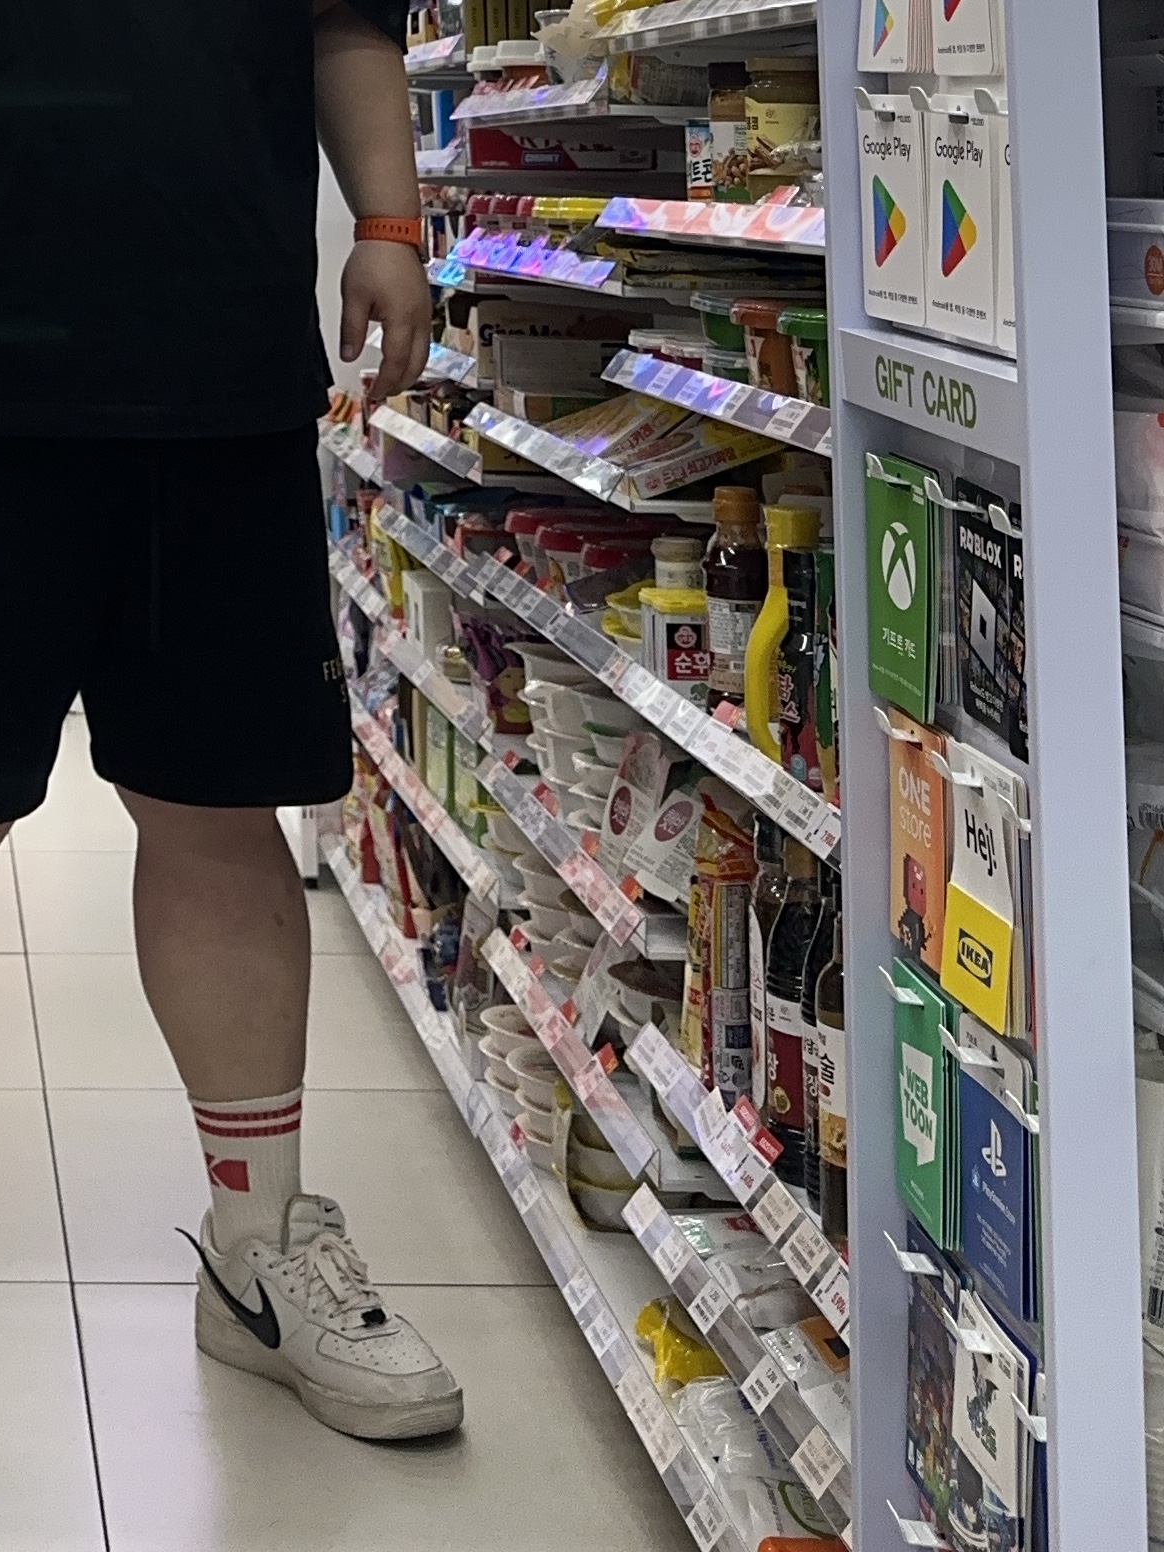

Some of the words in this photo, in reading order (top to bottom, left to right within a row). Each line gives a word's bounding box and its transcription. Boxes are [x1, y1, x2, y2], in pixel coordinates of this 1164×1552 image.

[863, 134, 892, 161] Google
[893, 136, 911, 163] Play
[934, 136, 965, 165] Google
[966, 140, 983, 168] Play
[874, 354, 916, 409] GIFT
[922, 370, 977, 430] CARD
[959, 525, 1002, 569] ROBLOX
[897, 764, 932, 817] ONE
[898, 803, 933, 850] store
[964, 808, 998, 877] Hej!
[961, 941, 992, 979] IKEA
[903, 1063, 932, 1111] WEB
[903, 1095, 935, 1142] TOON
